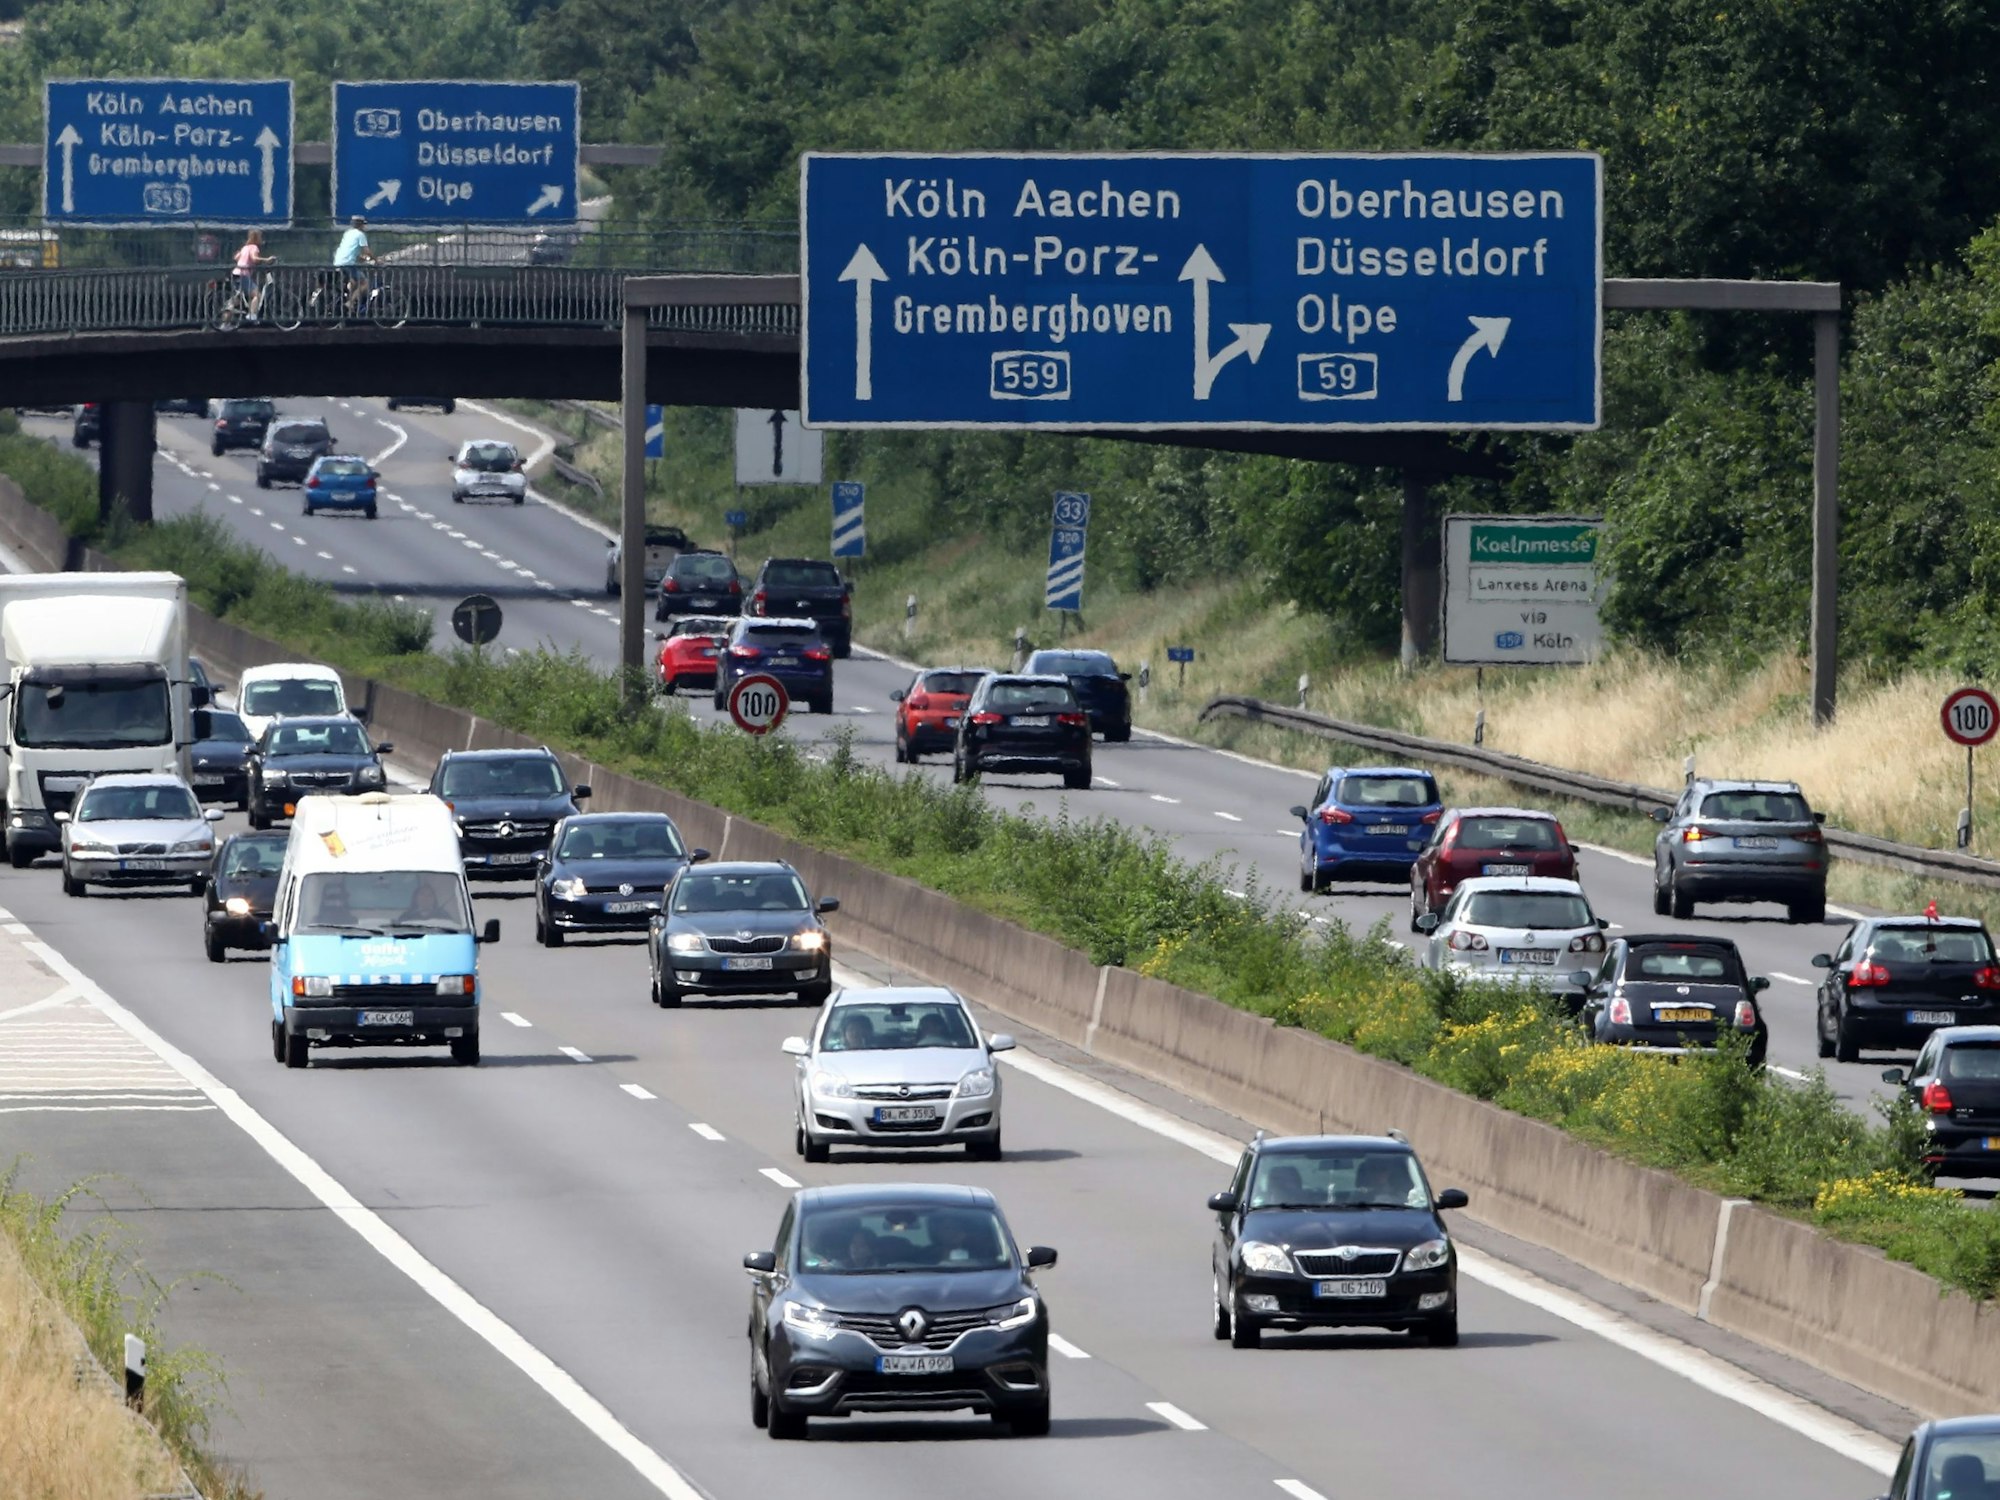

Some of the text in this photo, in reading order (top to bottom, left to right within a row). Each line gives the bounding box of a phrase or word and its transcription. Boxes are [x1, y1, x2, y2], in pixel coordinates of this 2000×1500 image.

[87, 91, 253, 116] Köln Aachen
[366, 113, 390, 131] 59
[417, 108, 562, 131] Oberhausen
[101, 122, 244, 147] Köln-Porz-
[88, 152, 250, 181] Gremberghoven
[418, 141, 553, 166] Düsseldorf
[417, 176, 473, 206] Olpe
[885, 178, 1180, 219] Köln Aachen
[1296, 179, 1563, 219] Oberhausen
[908, 235, 1158, 276] Köln-Porz-
[1296, 237, 1548, 277] Düsseldorf
[894, 293, 1172, 343] Gremberghoven
[1296, 294, 1397, 344] Olpe
[1002, 360, 1059, 389] 559
[1318, 362, 1357, 390] 59
[1060, 501, 1081, 520] 33
[1475, 535, 1591, 554] Koelnmesse
[1477, 577, 1588, 592] Lanxess Arena
[1520, 609, 1547, 624] via
[1533, 633, 1573, 649] Köln
[741, 691, 776, 717] 100
[1953, 704, 1989, 731] 100
